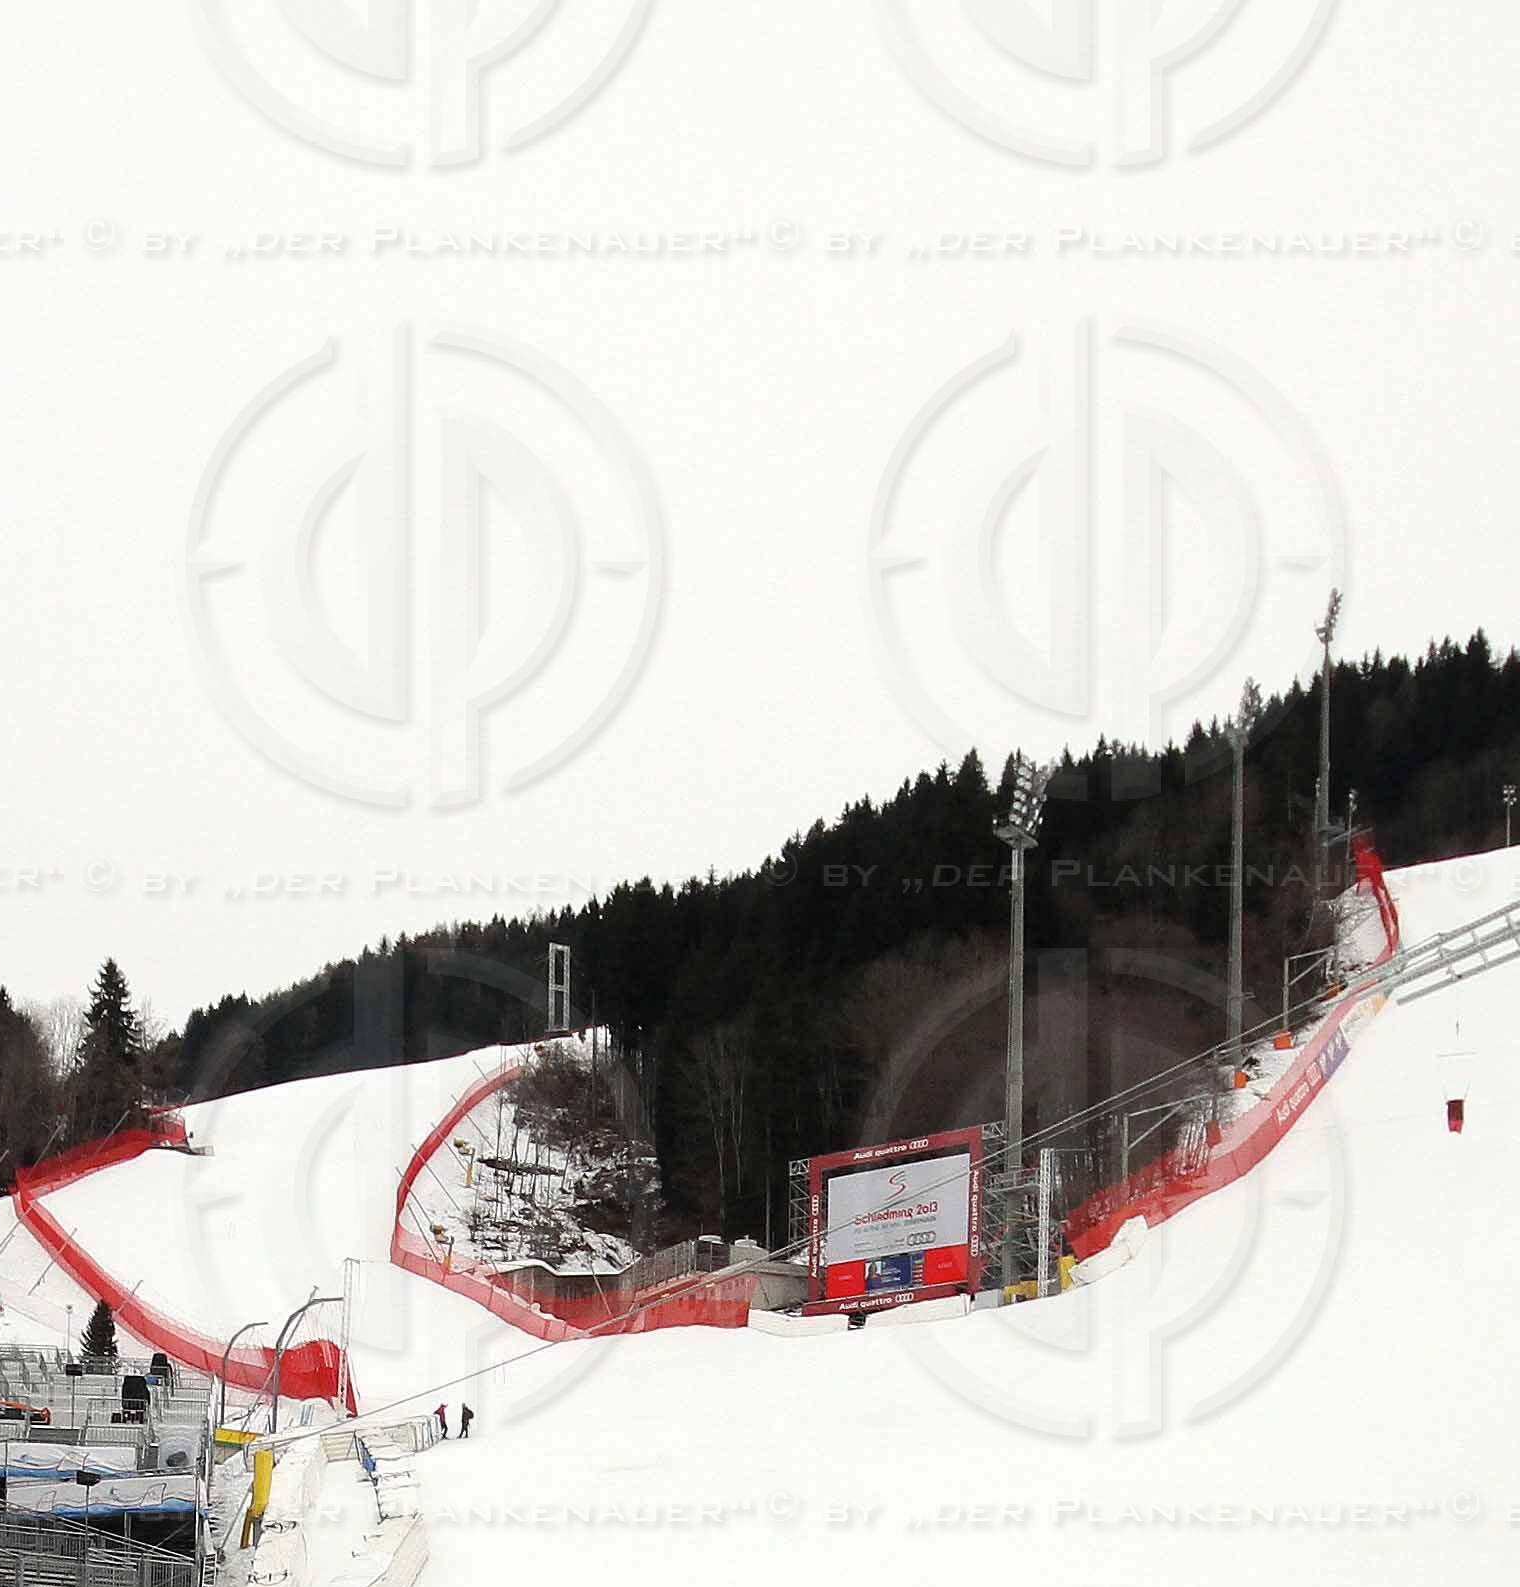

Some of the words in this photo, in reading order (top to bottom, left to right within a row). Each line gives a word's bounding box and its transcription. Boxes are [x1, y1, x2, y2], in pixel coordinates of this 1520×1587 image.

[853, 1150, 873, 1160] Audi
[874, 1144, 907, 1156] quattro
[839, 1302, 858, 1310] Audi
[860, 1297, 892, 1308] quattro
